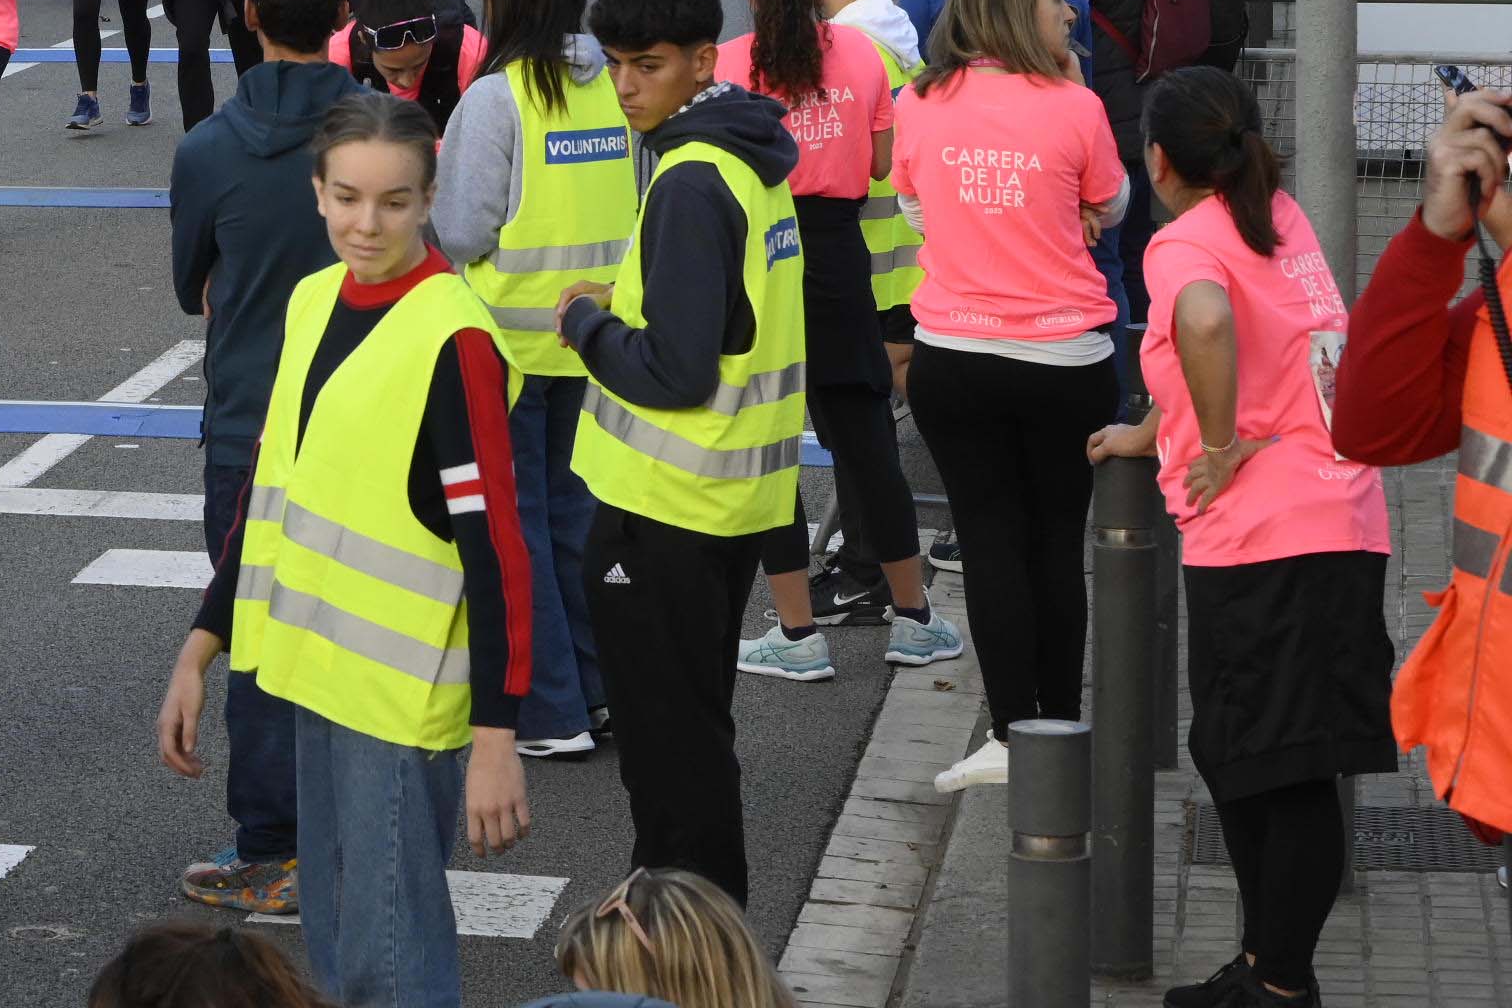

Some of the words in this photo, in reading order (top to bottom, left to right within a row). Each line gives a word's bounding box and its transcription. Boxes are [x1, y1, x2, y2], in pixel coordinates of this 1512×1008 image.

[790, 109, 812, 127] DE
[818, 105, 840, 123] LA
[790, 121, 843, 143] MUJER
[547, 135, 626, 156] VOLUNTARIS
[941, 146, 1042, 172] CARRERA
[960, 166, 987, 186] DE
[995, 168, 1022, 189] LA
[959, 186, 1025, 208] MUJER
[1300, 276, 1320, 297] DE
[950, 310, 1002, 328] OYSHO
[604, 575, 630, 584] adidas
